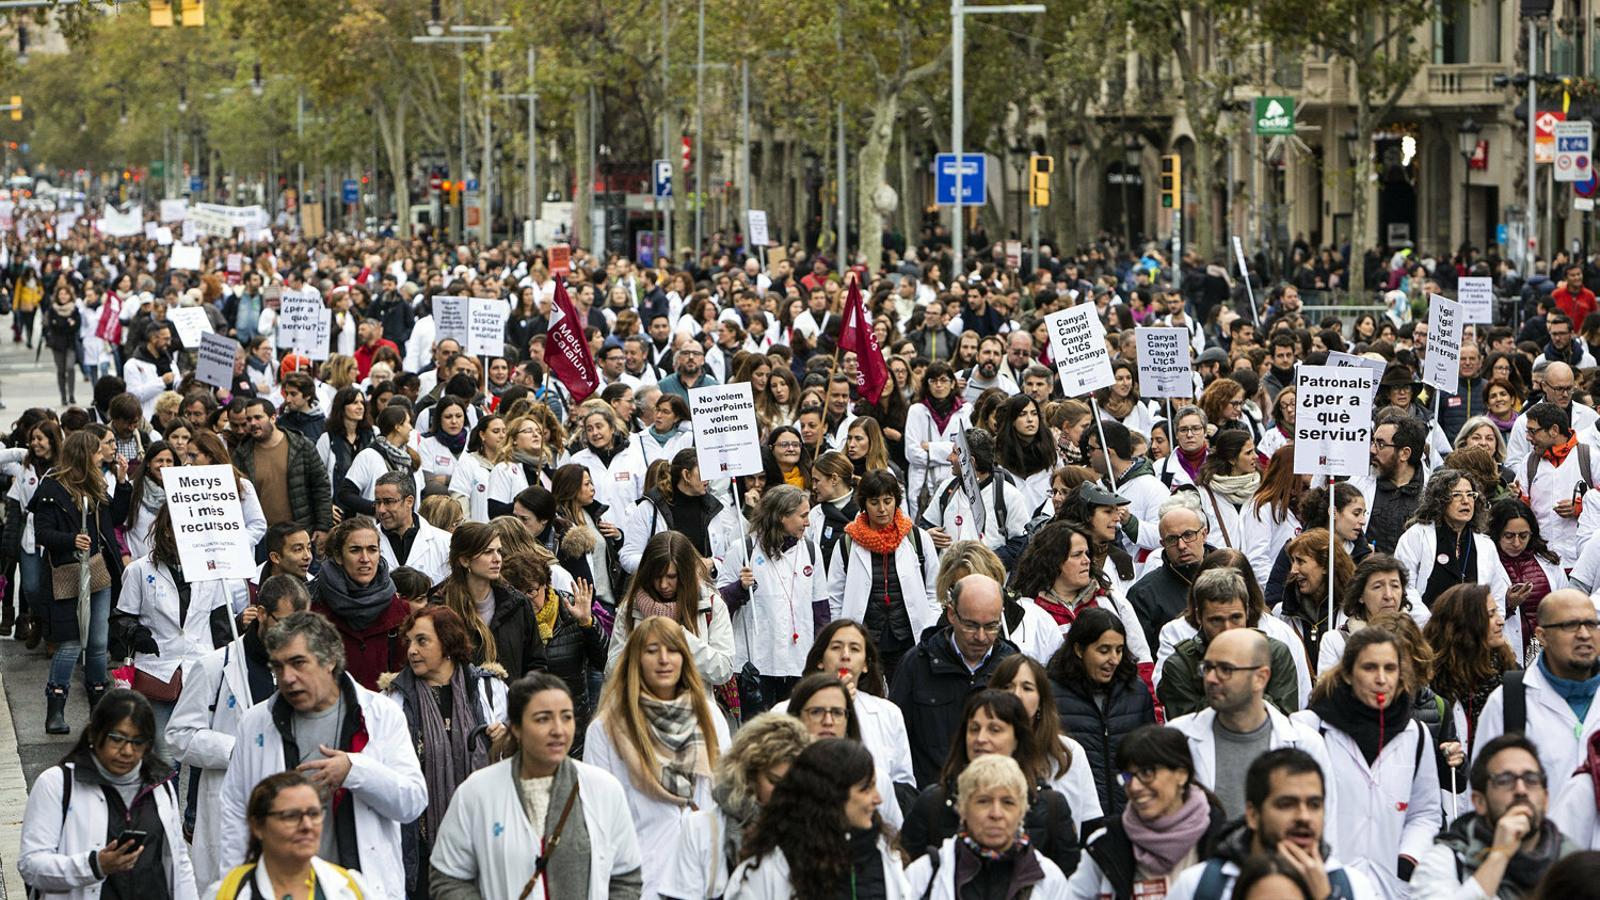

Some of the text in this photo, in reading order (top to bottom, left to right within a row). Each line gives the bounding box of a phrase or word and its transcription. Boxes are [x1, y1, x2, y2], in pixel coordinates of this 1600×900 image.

[658, 162, 672, 184] P
[1056, 311, 1087, 327] Canya!
[1058, 320, 1090, 336] Canya!
[1061, 330, 1092, 346] Canya!
[1147, 334, 1178, 342] Canya!
[1067, 341, 1091, 355] L'ICS
[1148, 341, 1178, 349] Canya!
[1058, 347, 1106, 368] m'escanya
[1148, 349, 1179, 358] Canya!
[1153, 357, 1176, 365] L'ICS
[1141, 365, 1189, 373] m'escanya
[1300, 375, 1371, 389] Patronals
[699, 392, 744, 404] No volem
[1302, 394, 1360, 408] ¿per a
[693, 402, 753, 415] PowerPoints
[710, 414, 738, 424] volem
[1317, 409, 1351, 426] què
[703, 423, 749, 436] solucions
[1299, 428, 1368, 442] serviu?
[171, 492, 237, 503] discursos
[189, 506, 194, 517] i
[181, 521, 240, 533] recursos
